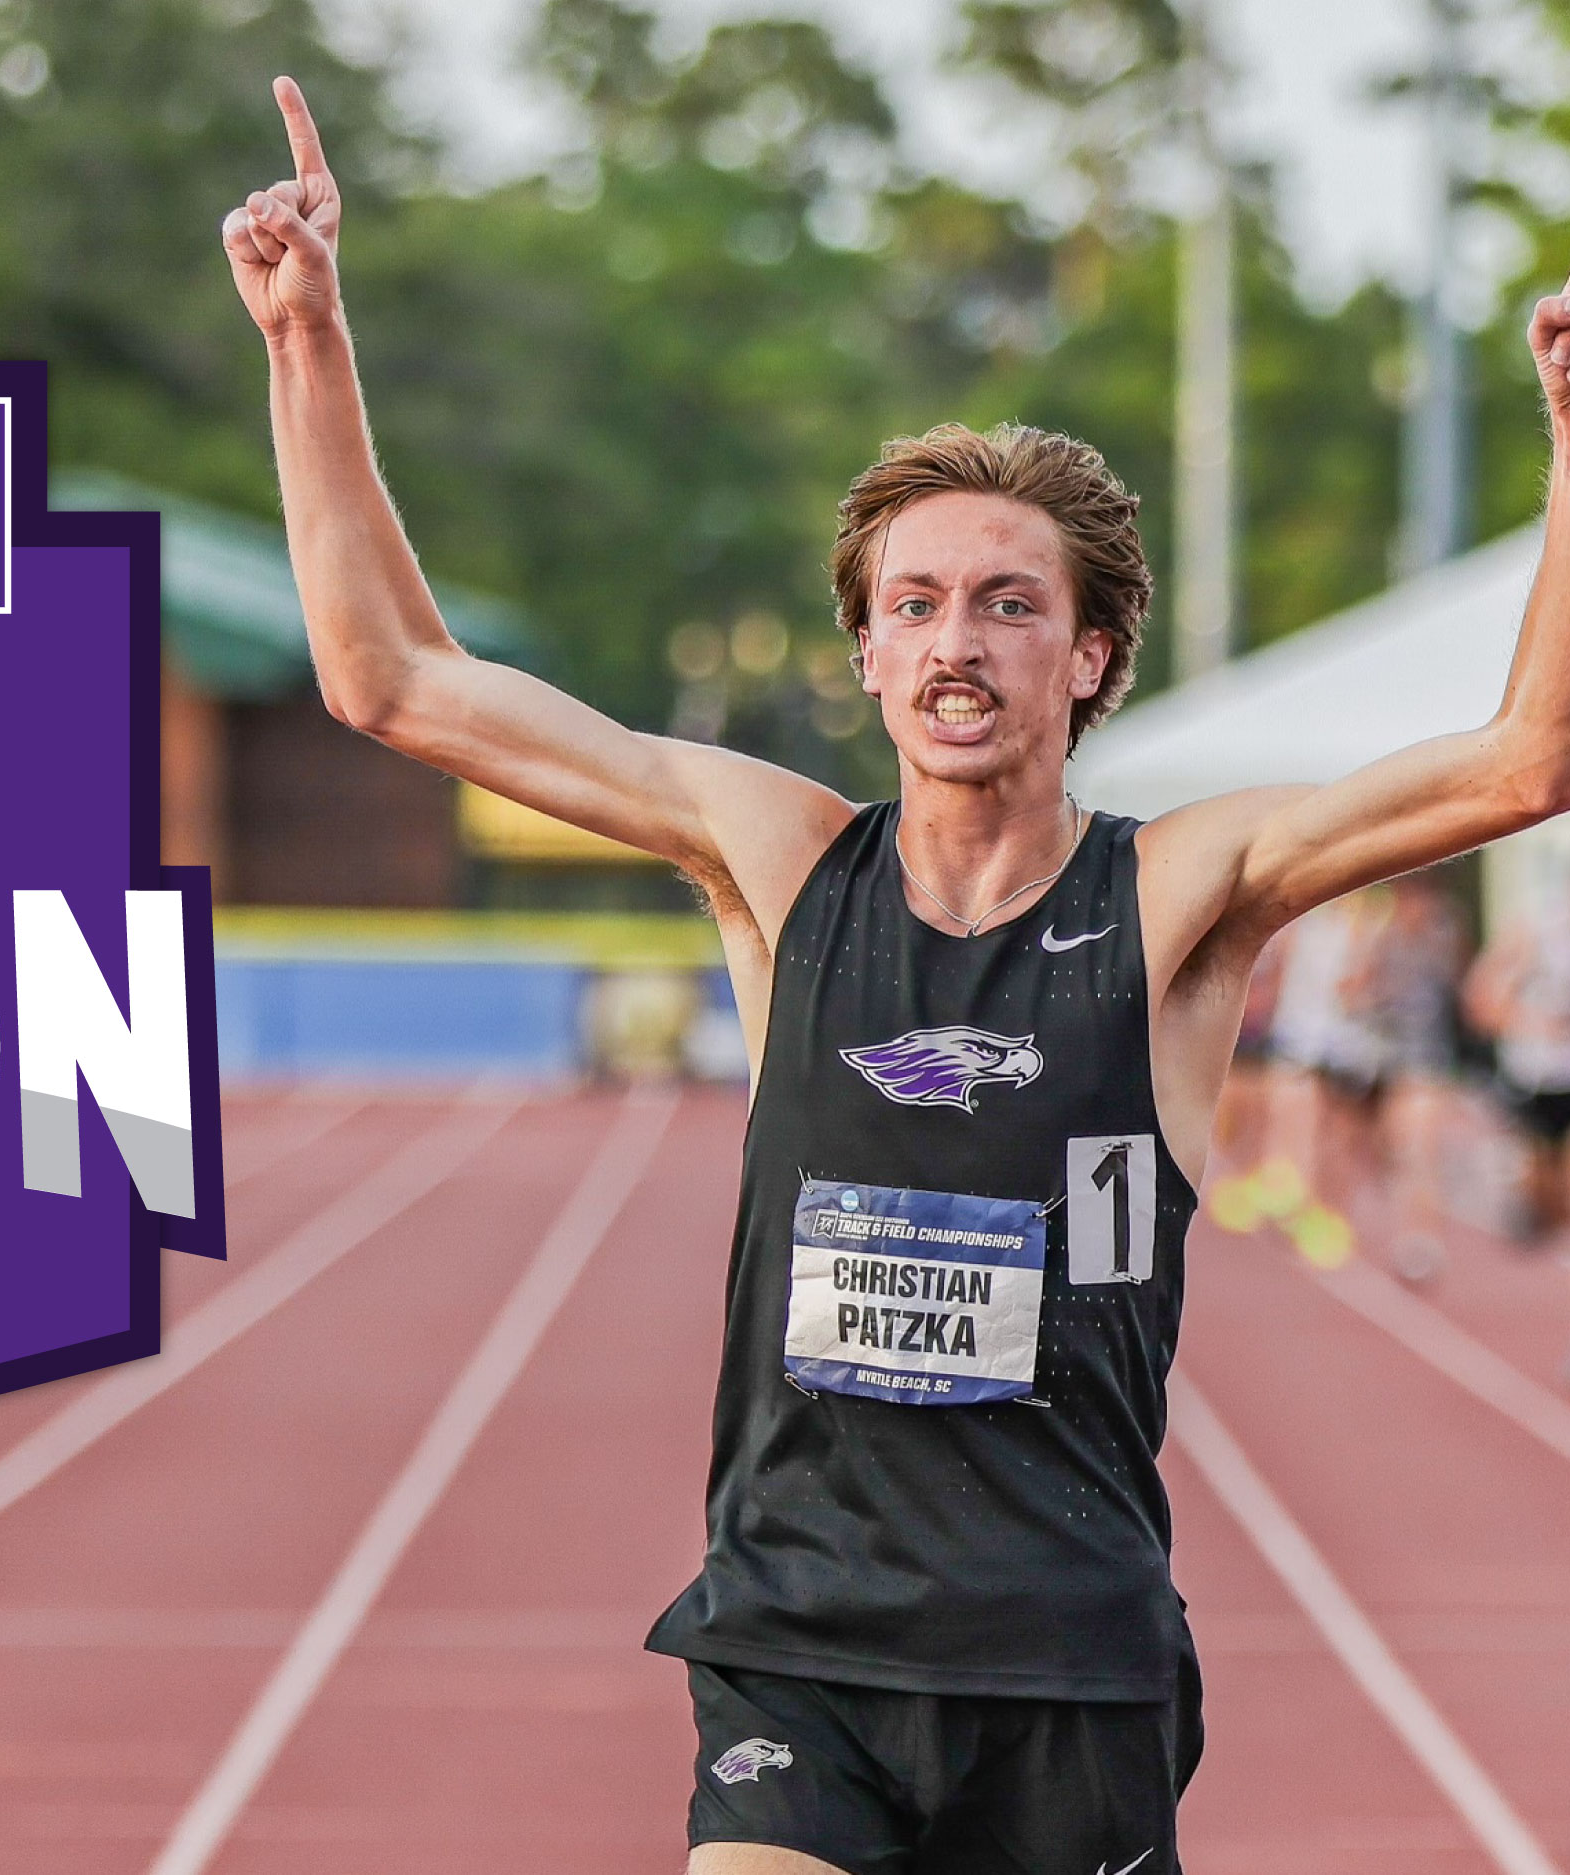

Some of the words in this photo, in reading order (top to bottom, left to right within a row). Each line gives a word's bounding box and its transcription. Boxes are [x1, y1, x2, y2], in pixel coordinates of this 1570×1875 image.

[1091, 1147, 1129, 1273] 1
[837, 1219, 871, 1234] TRACK
[882, 1223, 915, 1240] FIELD
[917, 1227, 1023, 1250] CHAMPIONSHIPS
[833, 1257, 992, 1304] CHRISTIAN
[838, 1303, 977, 1357] PATZKA
[856, 1369, 891, 1388] MYRTLE
[891, 1375, 931, 1392] BEACH,
[934, 1379, 952, 1392] SC
